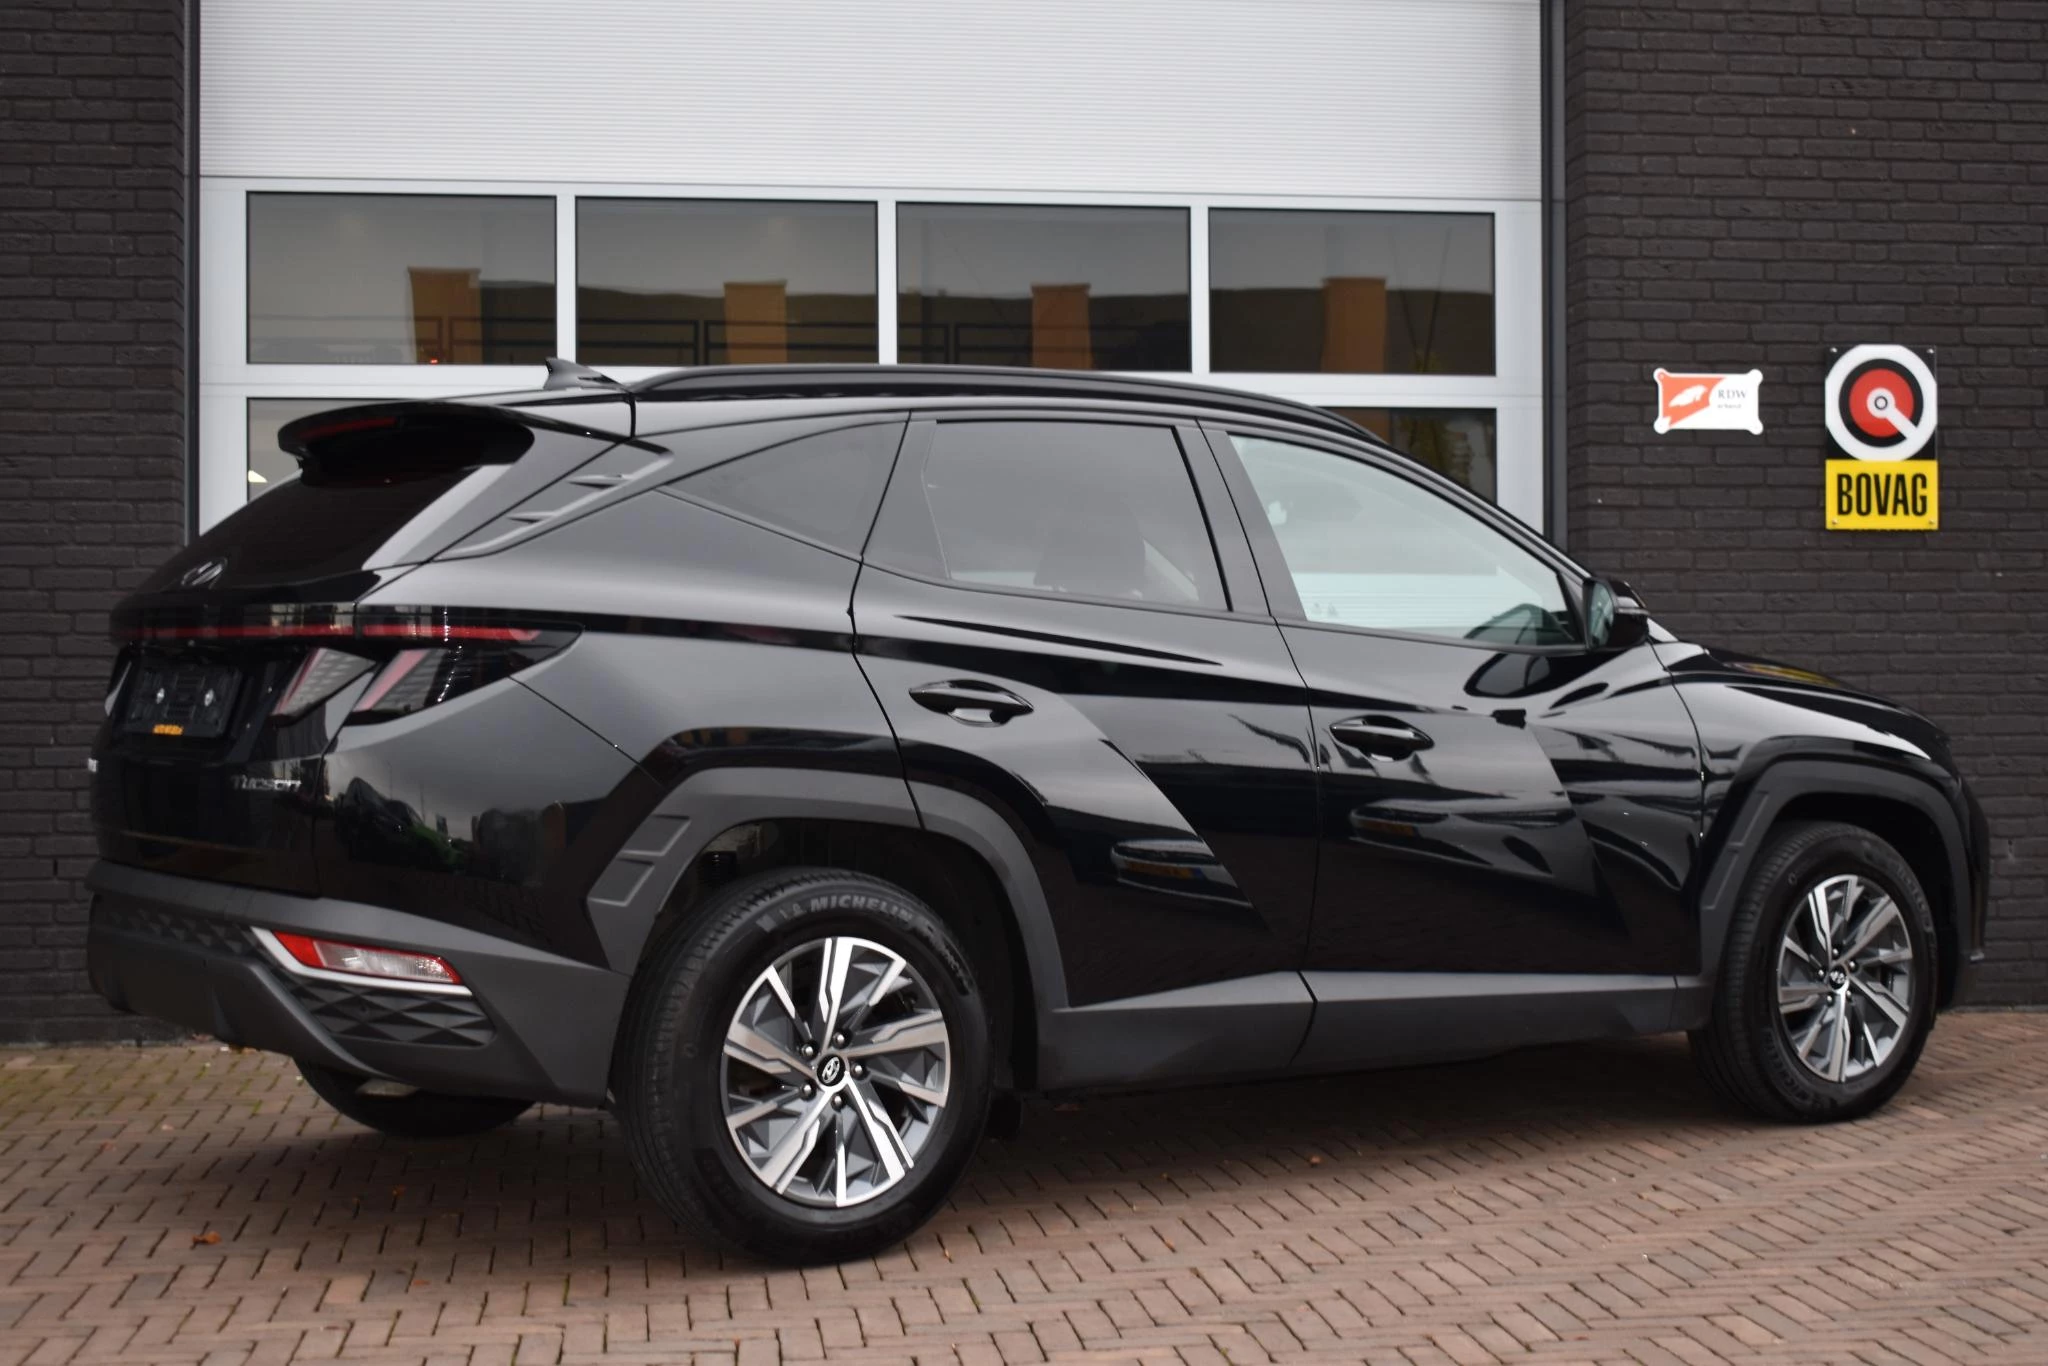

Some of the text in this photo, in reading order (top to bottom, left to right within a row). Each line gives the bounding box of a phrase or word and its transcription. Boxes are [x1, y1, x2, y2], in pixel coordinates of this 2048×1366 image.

[1717, 388, 1747, 399] RDW
[1837, 473, 1927, 516] BOVAG
[811, 894, 914, 920] MICHELIN
